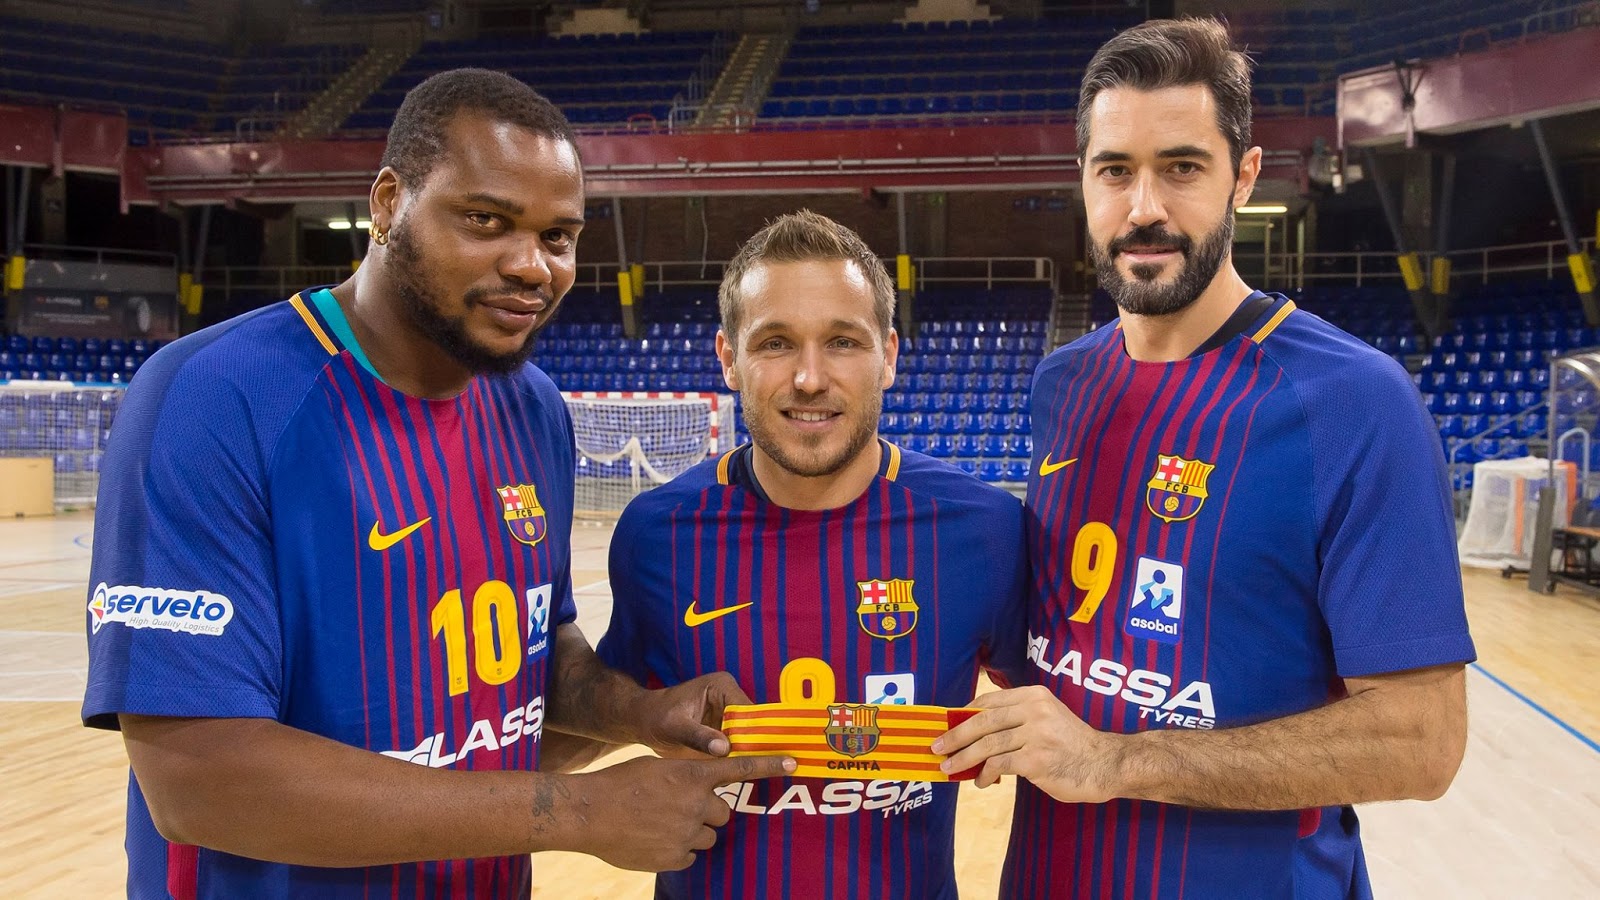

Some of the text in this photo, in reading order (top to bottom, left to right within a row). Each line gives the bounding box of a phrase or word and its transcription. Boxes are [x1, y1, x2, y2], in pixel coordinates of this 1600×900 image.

[1067, 521, 1118, 624] 9
[106, 594, 226, 621] serveto
[129, 616, 220, 633] High Quality Logistics
[431, 579, 522, 697] 10
[1130, 617, 1178, 635] asobal
[527, 636, 547, 655] asobal
[1036, 638, 1217, 718] LASSA
[428, 695, 545, 768] LASS
[1138, 706, 1216, 730] TYRES
[826, 760, 881, 771] CAPITÀ
[735, 779, 933, 815] LASSA
[881, 791, 933, 819] TYRES
